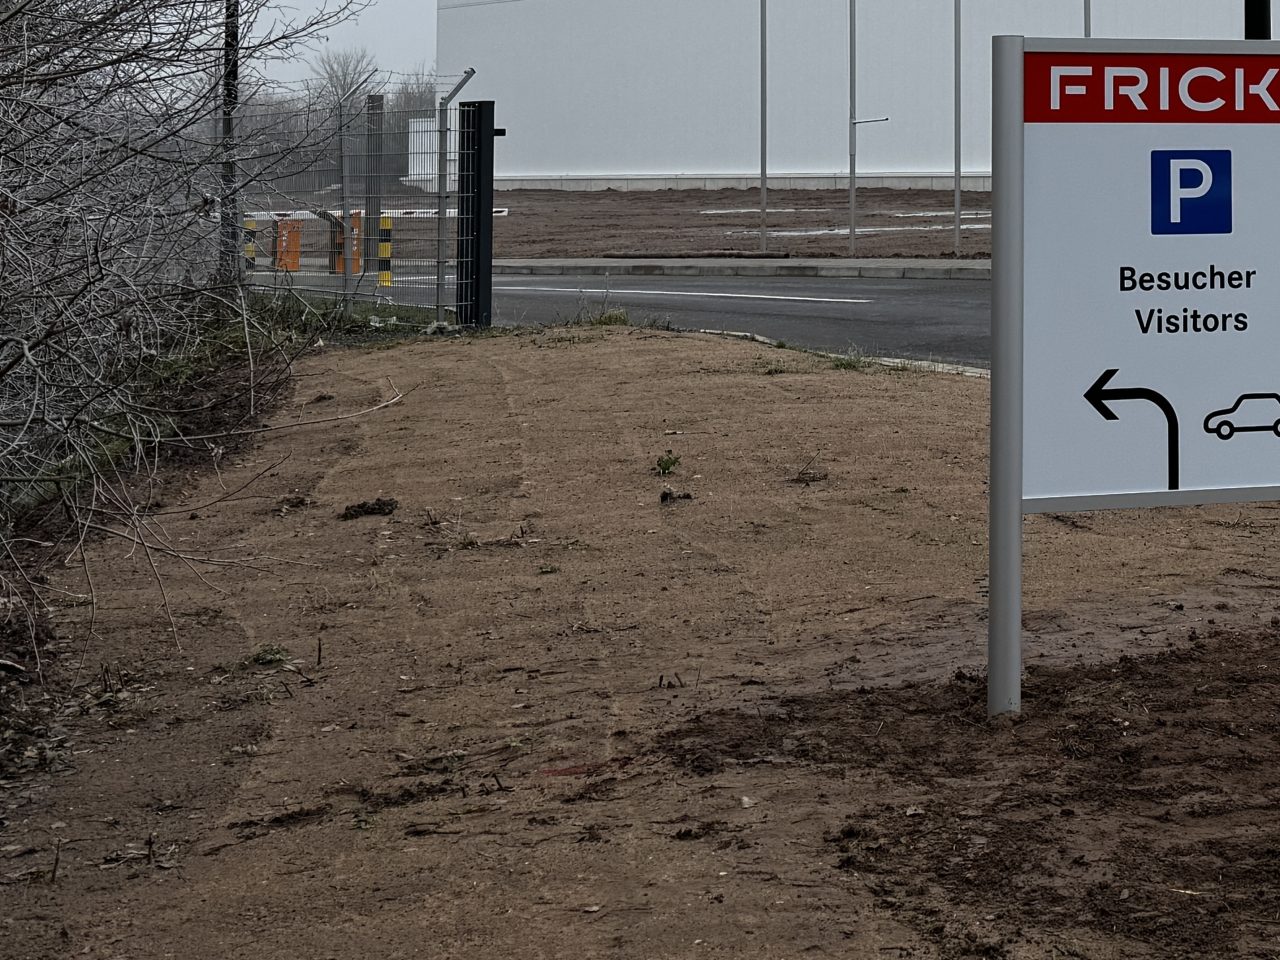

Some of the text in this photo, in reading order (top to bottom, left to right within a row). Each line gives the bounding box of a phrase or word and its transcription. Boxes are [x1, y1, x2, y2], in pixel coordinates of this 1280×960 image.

[1169, 158, 1213, 223] P
[1119, 264, 1257, 292] Besucher
[1134, 307, 1249, 334] Visitors
